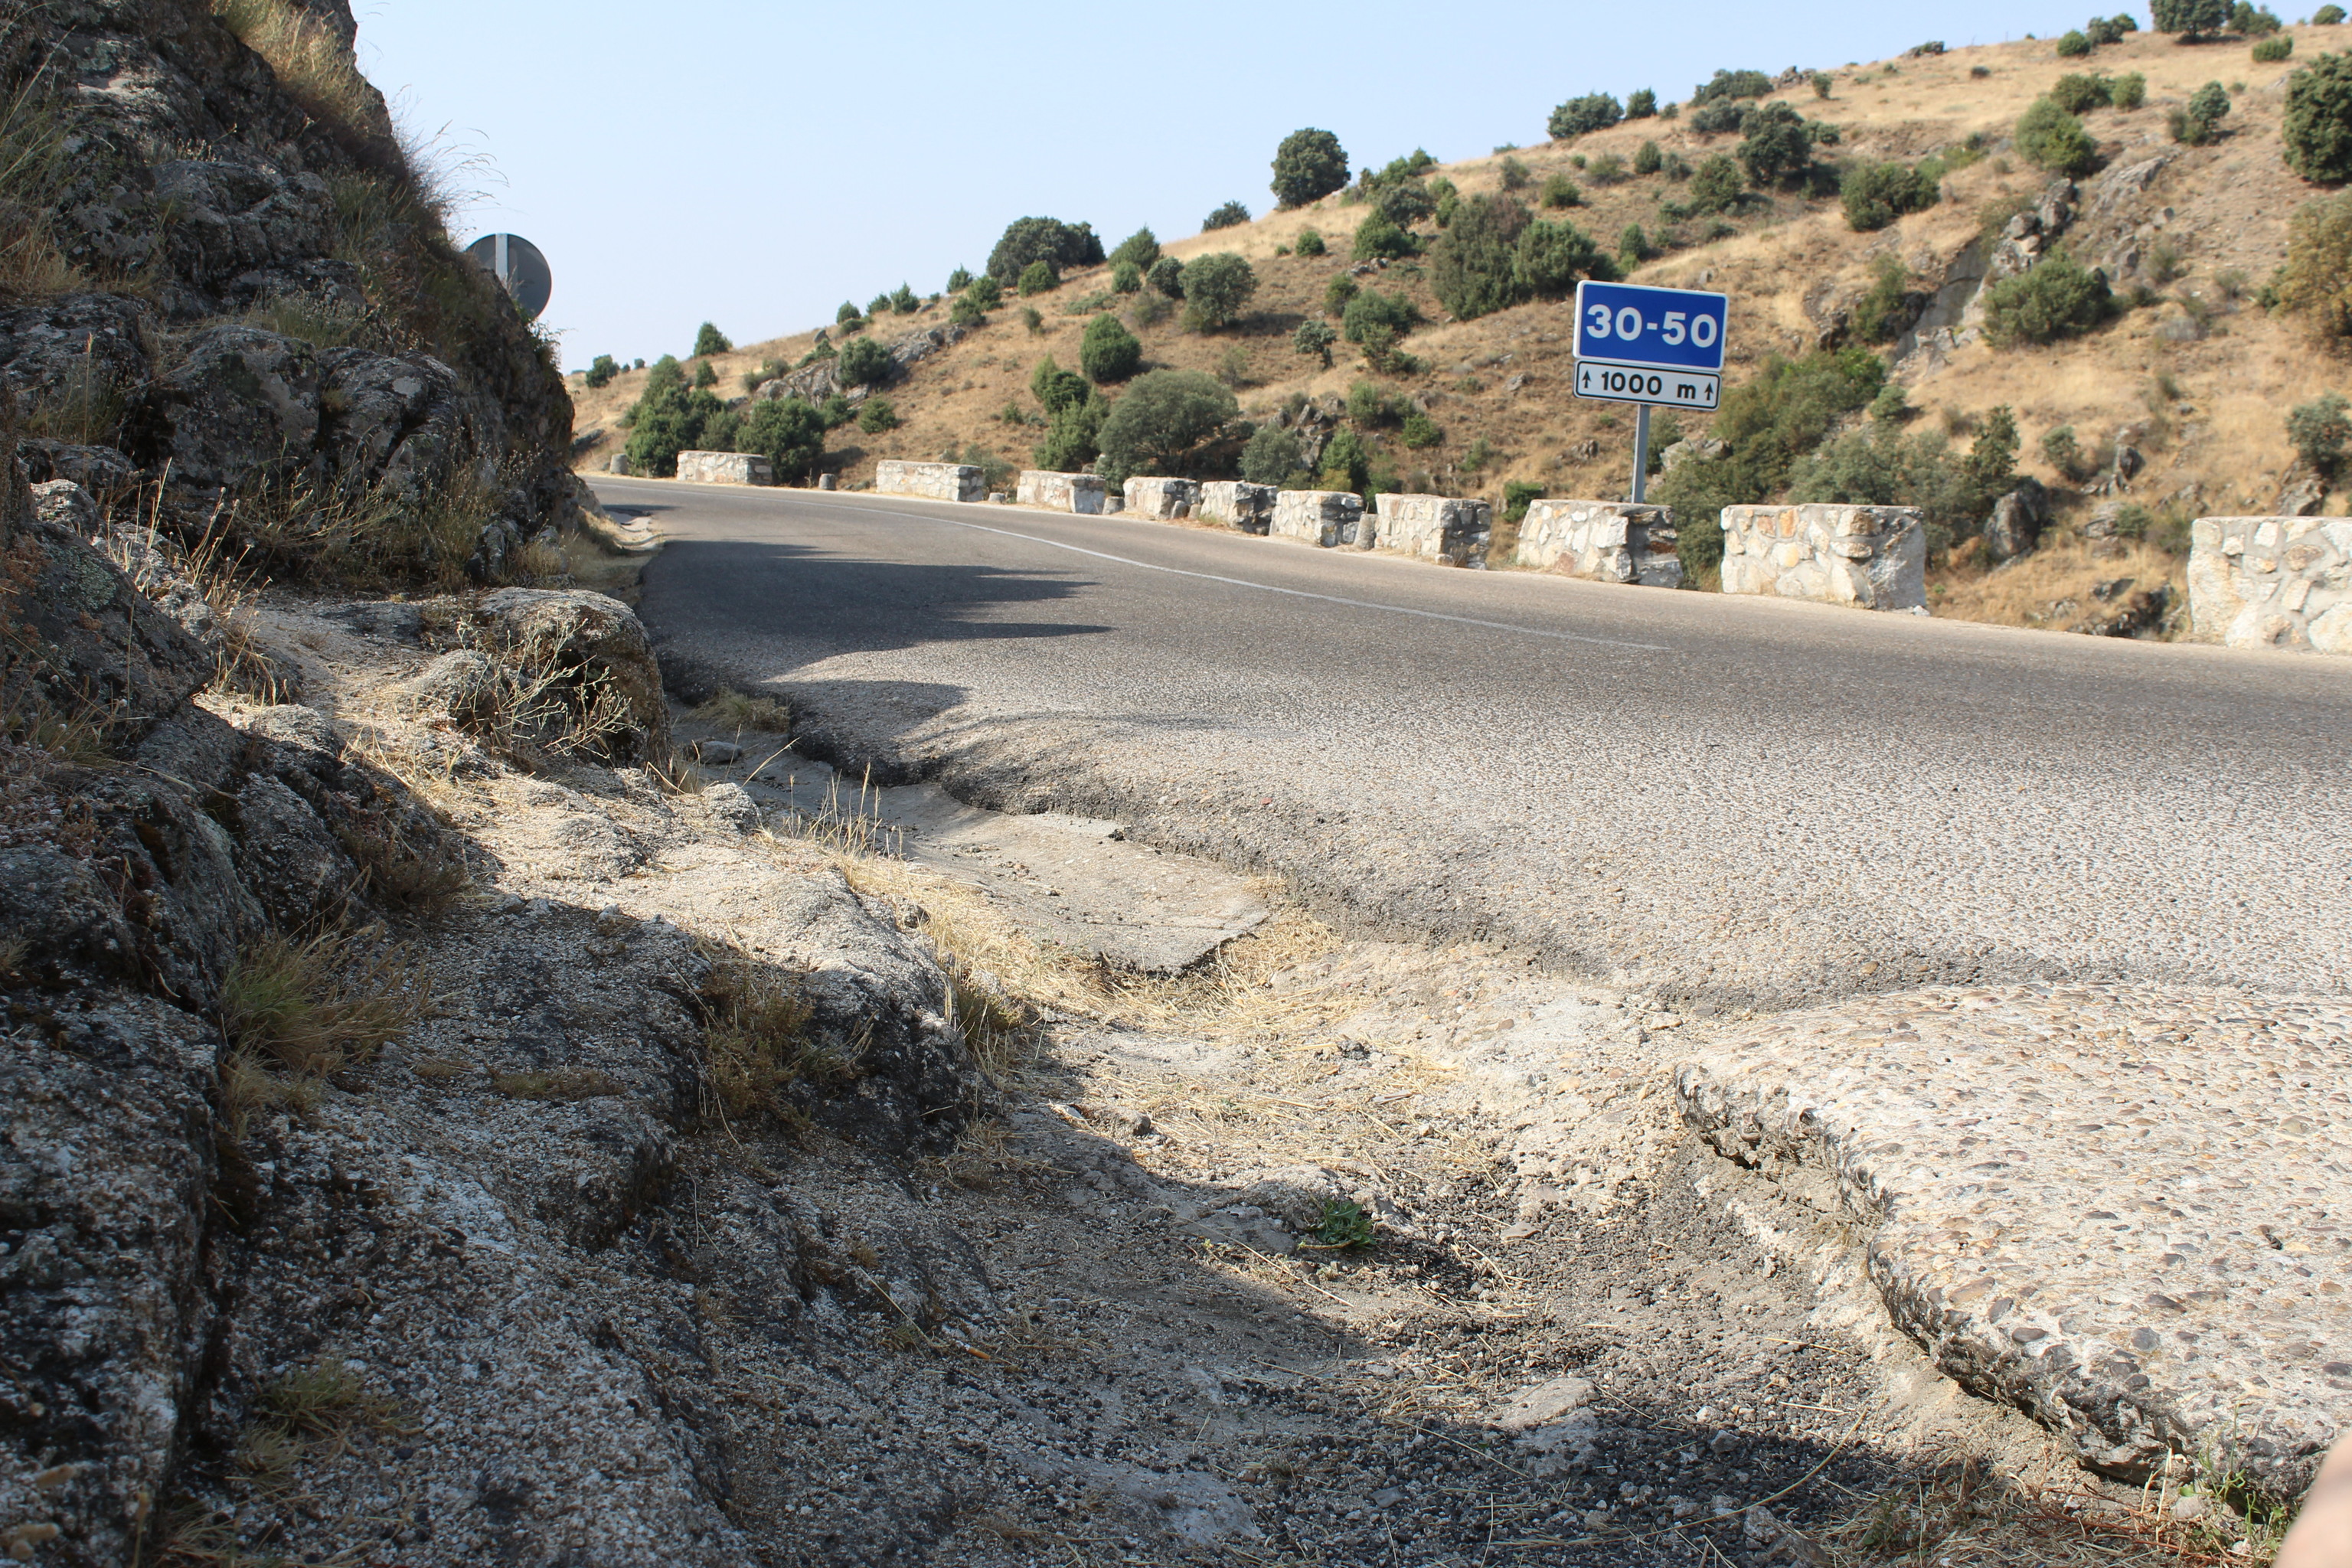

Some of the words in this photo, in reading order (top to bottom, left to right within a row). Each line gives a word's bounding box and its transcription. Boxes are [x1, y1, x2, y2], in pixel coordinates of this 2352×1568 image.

[1586, 304, 1717, 348] 30-50
[1601, 371, 1662, 396] 1000
[1677, 384, 1697, 400] m
